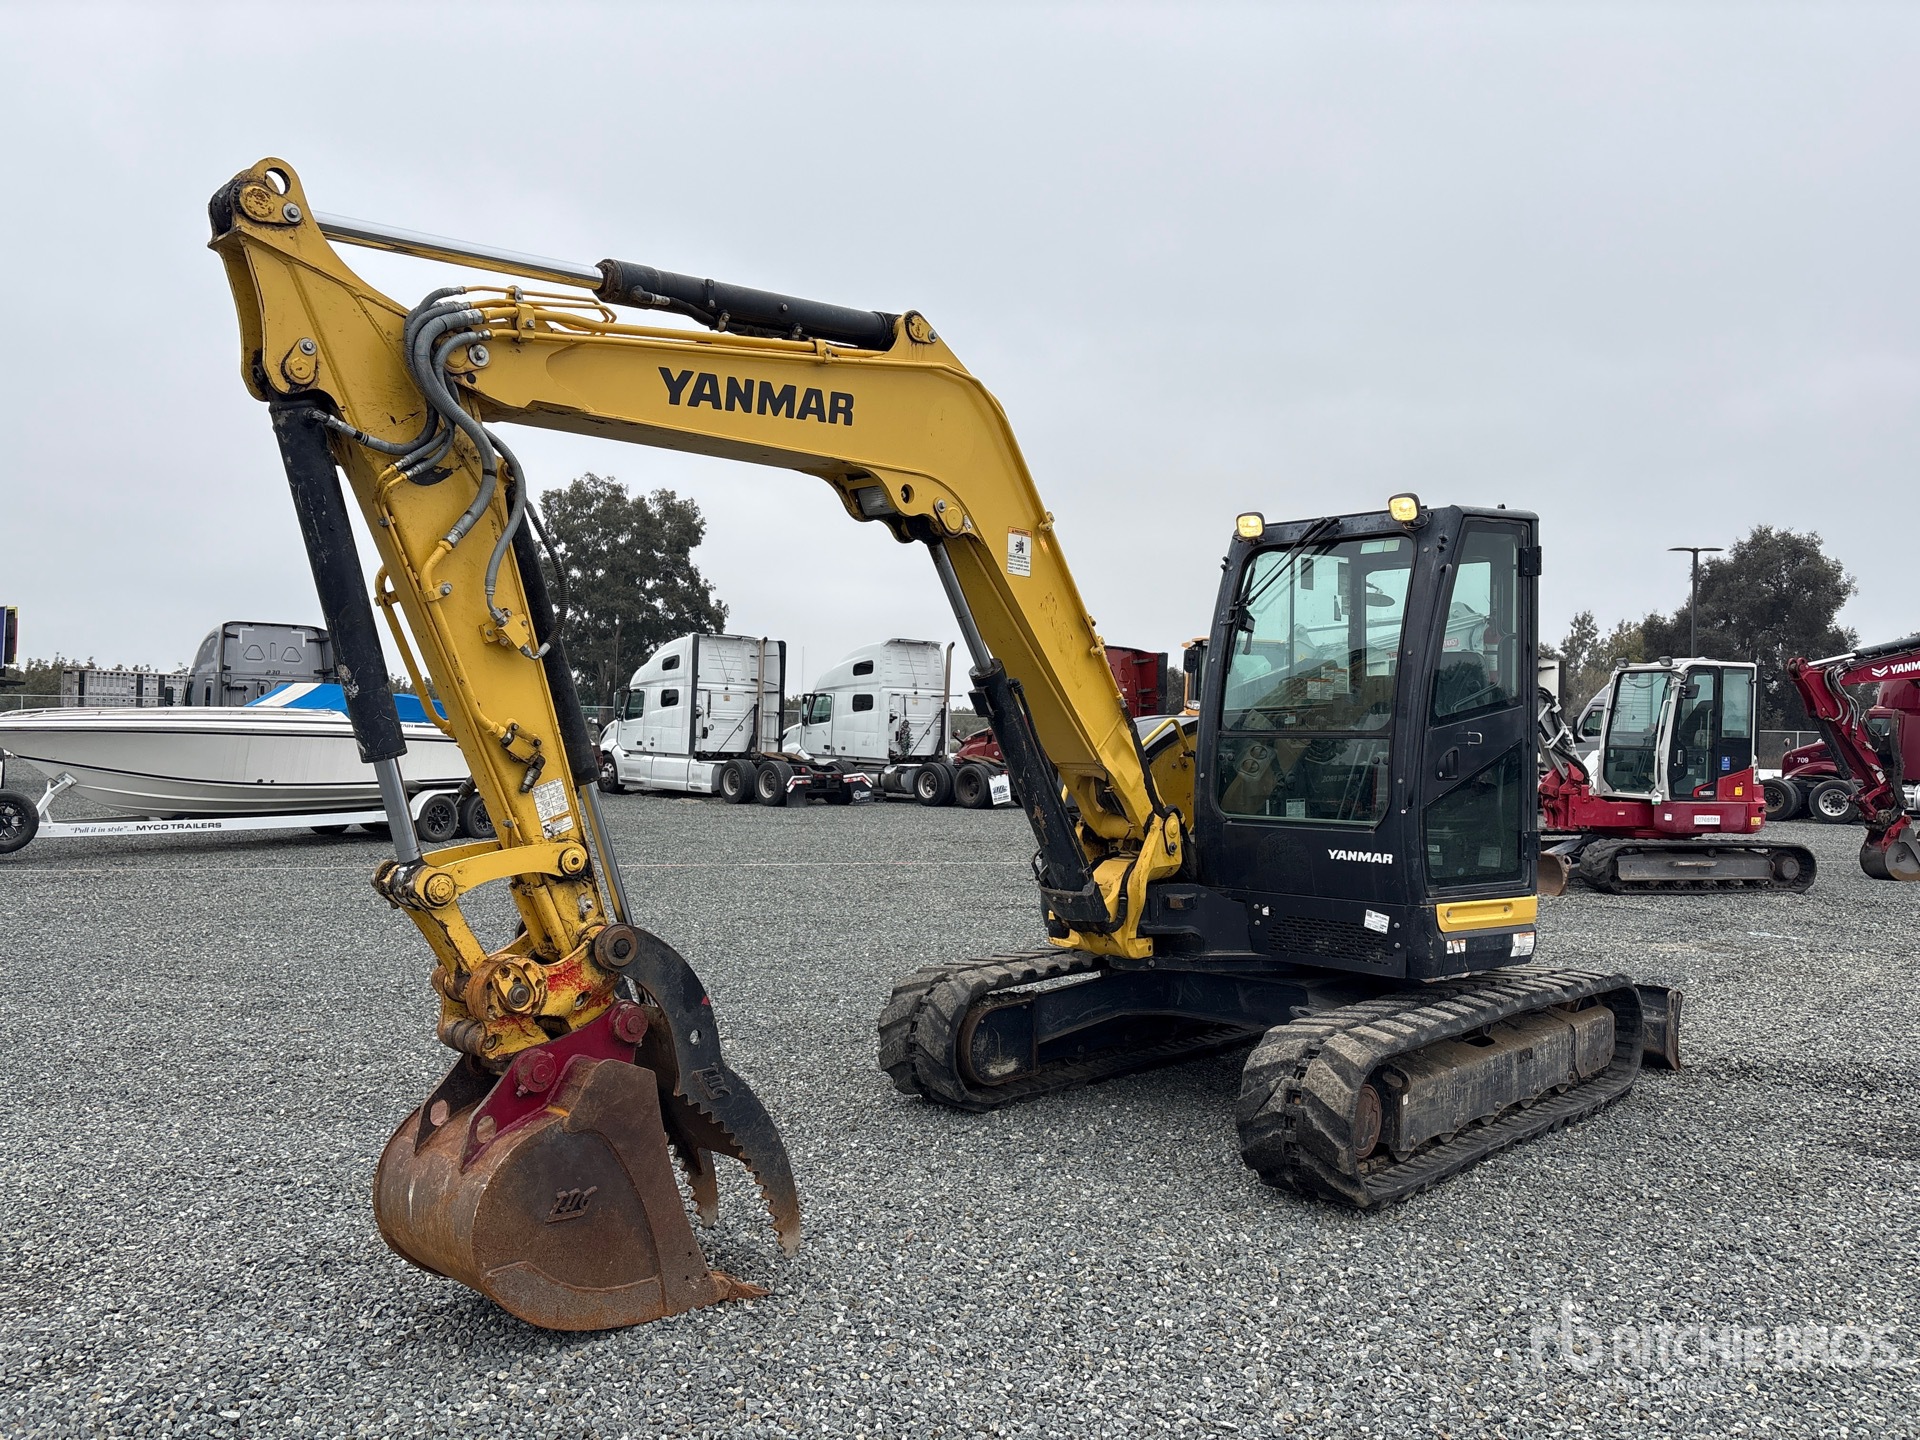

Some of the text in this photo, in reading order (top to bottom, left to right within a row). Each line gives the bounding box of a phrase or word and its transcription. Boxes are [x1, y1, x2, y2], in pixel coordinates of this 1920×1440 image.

[658, 366, 854, 426] YANMAR
[1796, 756, 1809, 764] 709
[170, 822, 222, 830] TRAILERS
[1327, 848, 1394, 865] YANMAR
